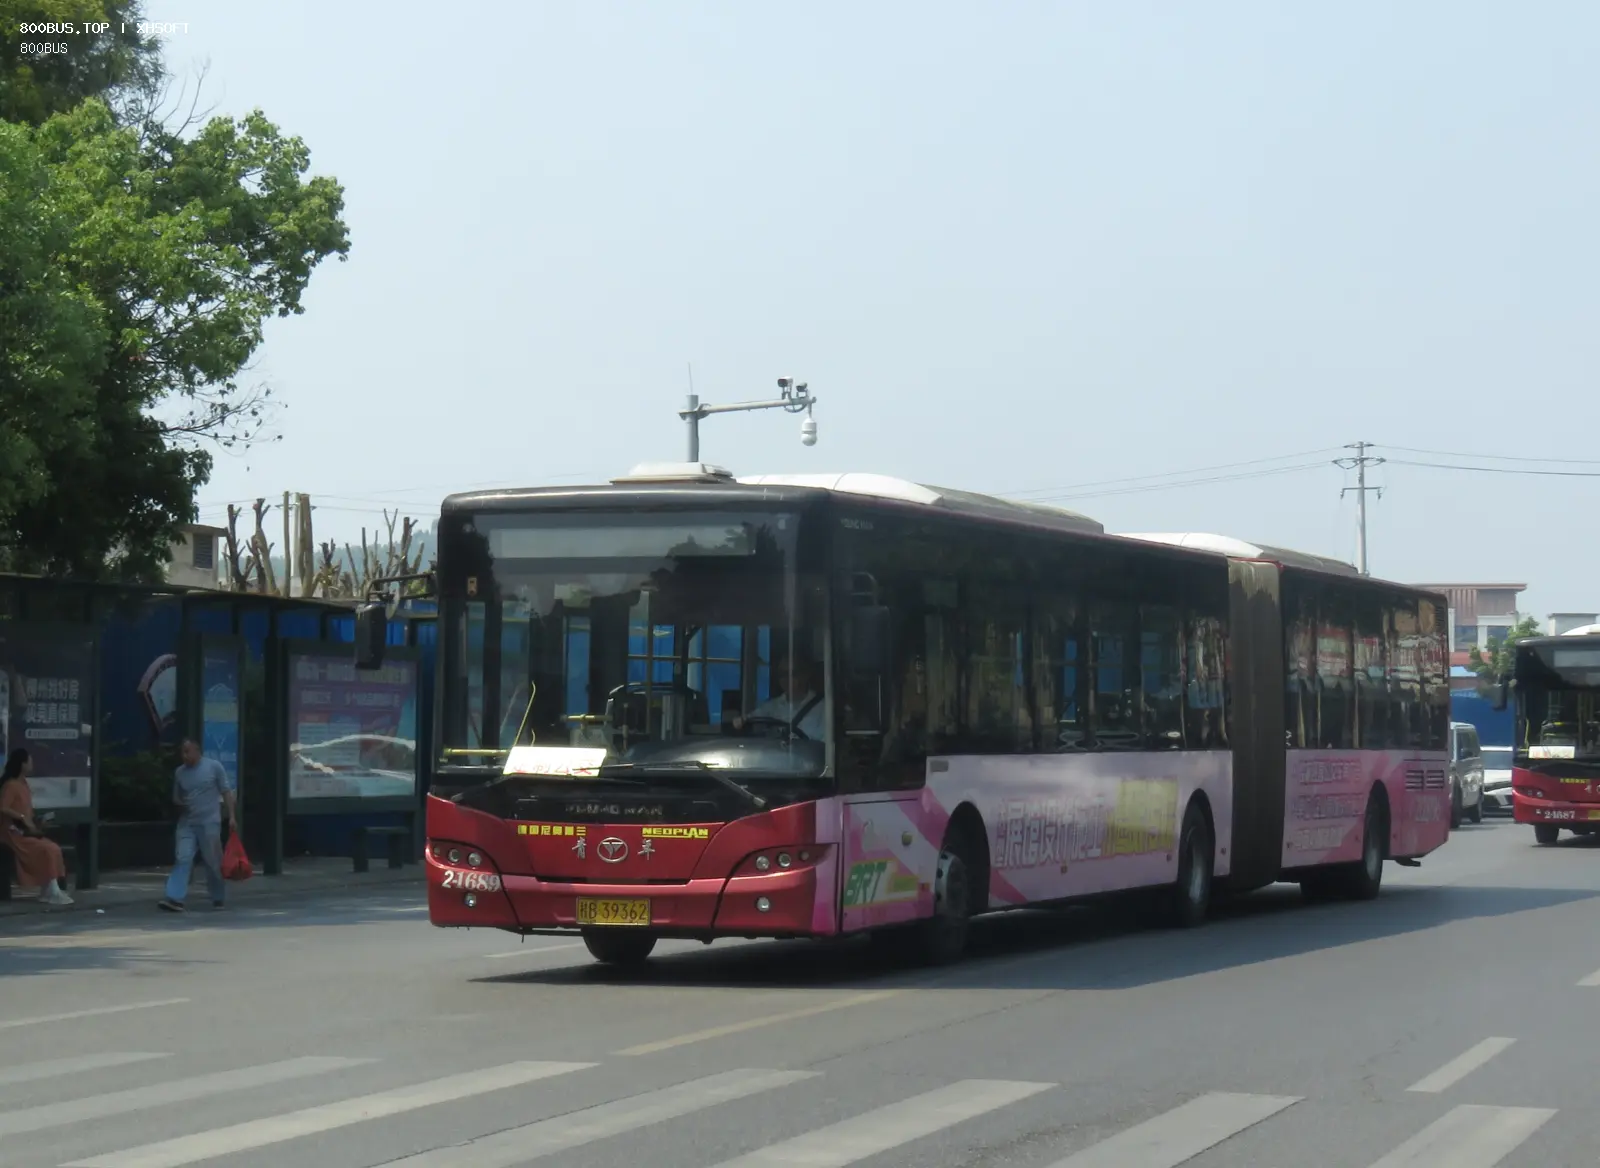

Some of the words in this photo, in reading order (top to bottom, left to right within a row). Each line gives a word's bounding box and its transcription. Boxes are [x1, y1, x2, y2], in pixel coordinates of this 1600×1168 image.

[642, 827, 709, 839] NEOPLAN
[441, 869, 501, 893] 2-1689
[844, 861, 888, 905] BRT
